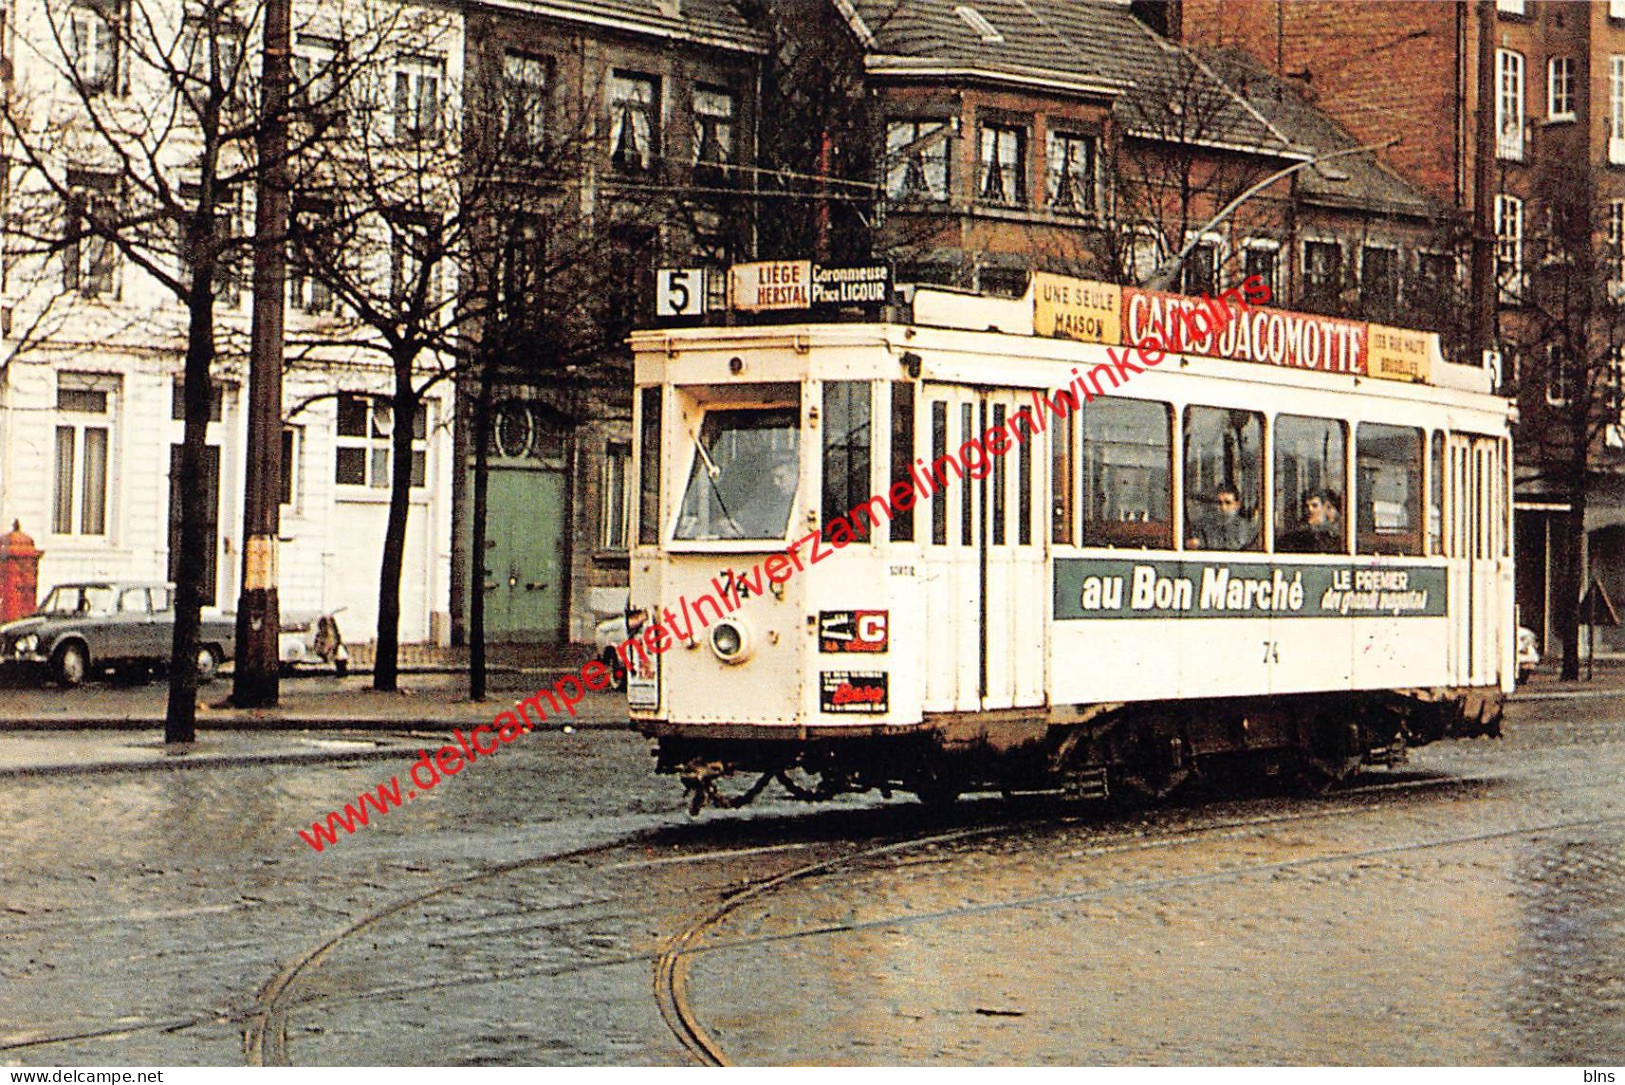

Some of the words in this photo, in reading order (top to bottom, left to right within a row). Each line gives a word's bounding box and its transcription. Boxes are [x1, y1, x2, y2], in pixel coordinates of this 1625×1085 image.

[667, 271, 690, 313] 5
[757, 286, 808, 305] HERSTAL
[841, 282, 885, 302] LICOUR
[1043, 285, 1069, 304] UNE
[1076, 289, 1114, 312] SEULE
[1055, 313, 1105, 338] MAISON
[1082, 576, 1122, 610] au
[1131, 565, 1193, 610] Bon
[1201, 567, 1303, 611] Marché
[1333, 570, 1351, 590] LE
